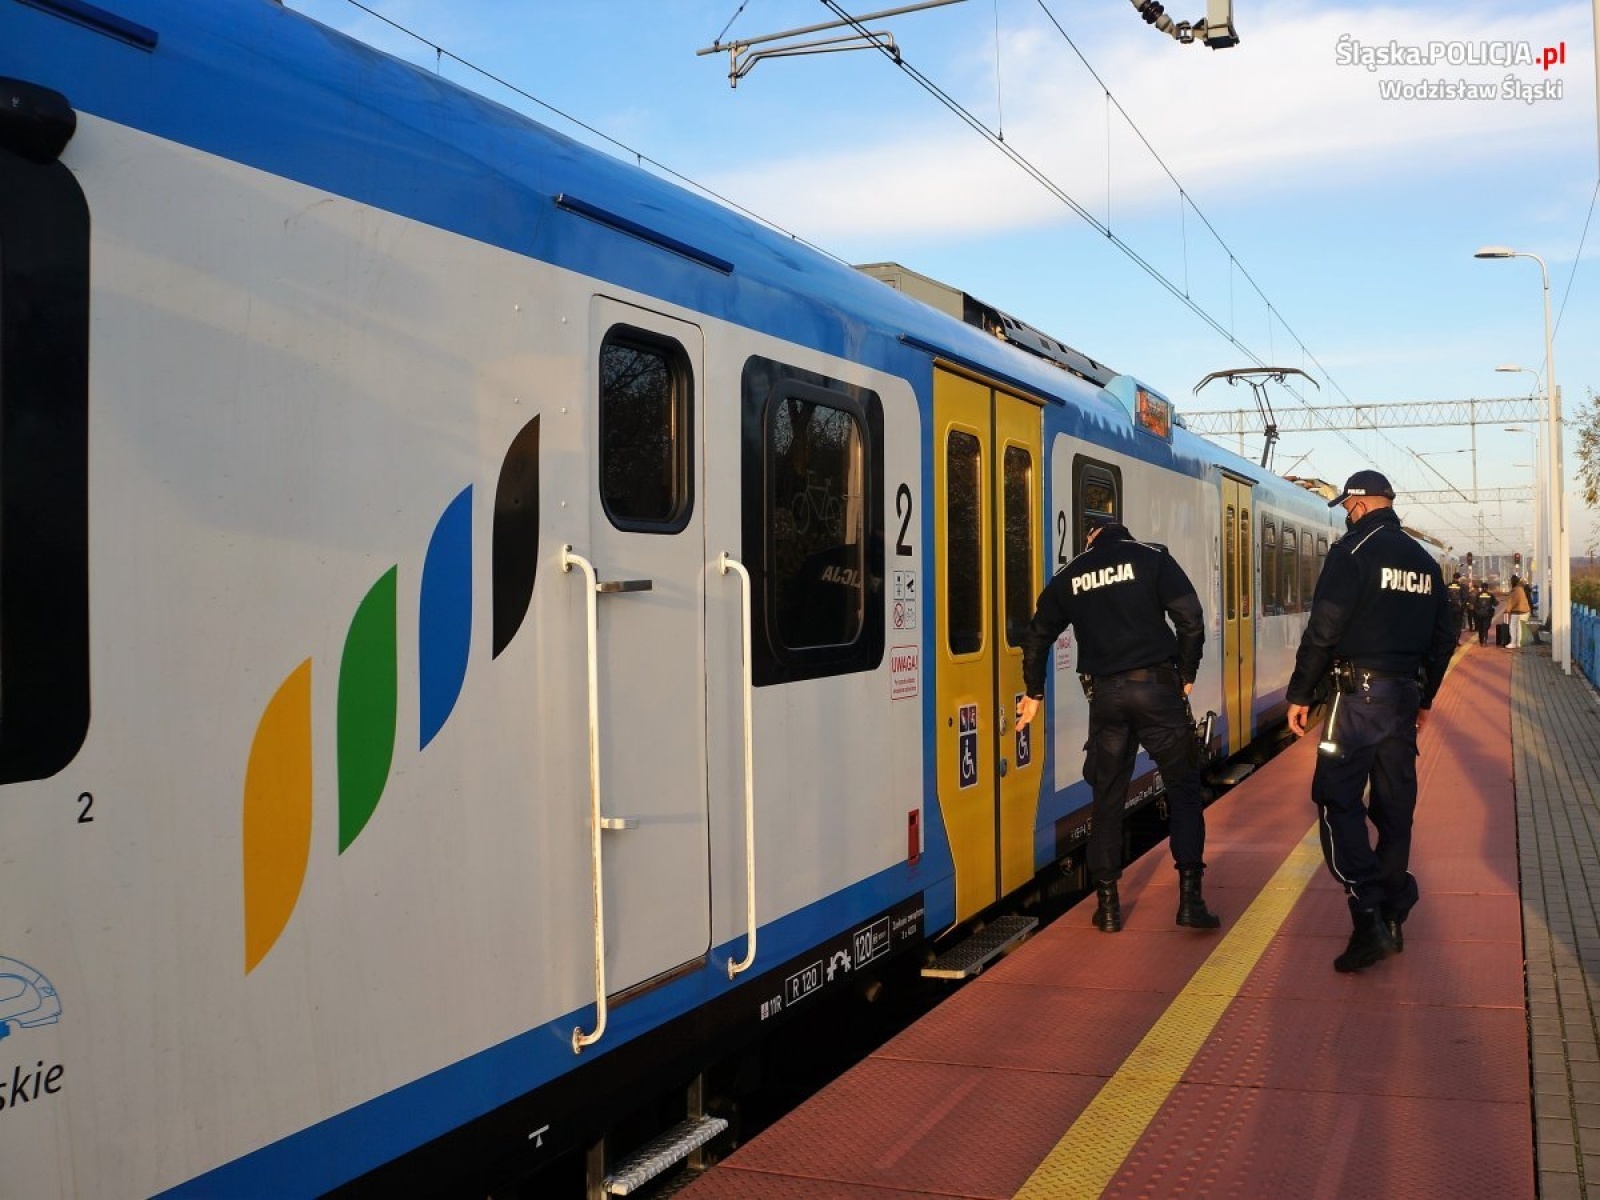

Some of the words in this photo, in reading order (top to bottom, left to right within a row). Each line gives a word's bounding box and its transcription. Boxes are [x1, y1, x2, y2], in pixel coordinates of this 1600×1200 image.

[895, 482, 913, 557] 2
[1058, 510, 1067, 565] 2
[1071, 563, 1135, 595] POLICJA
[77, 791, 94, 824] 2
[855, 932, 872, 965] 120
[792, 978, 800, 999] R
[802, 967, 818, 994] 120
